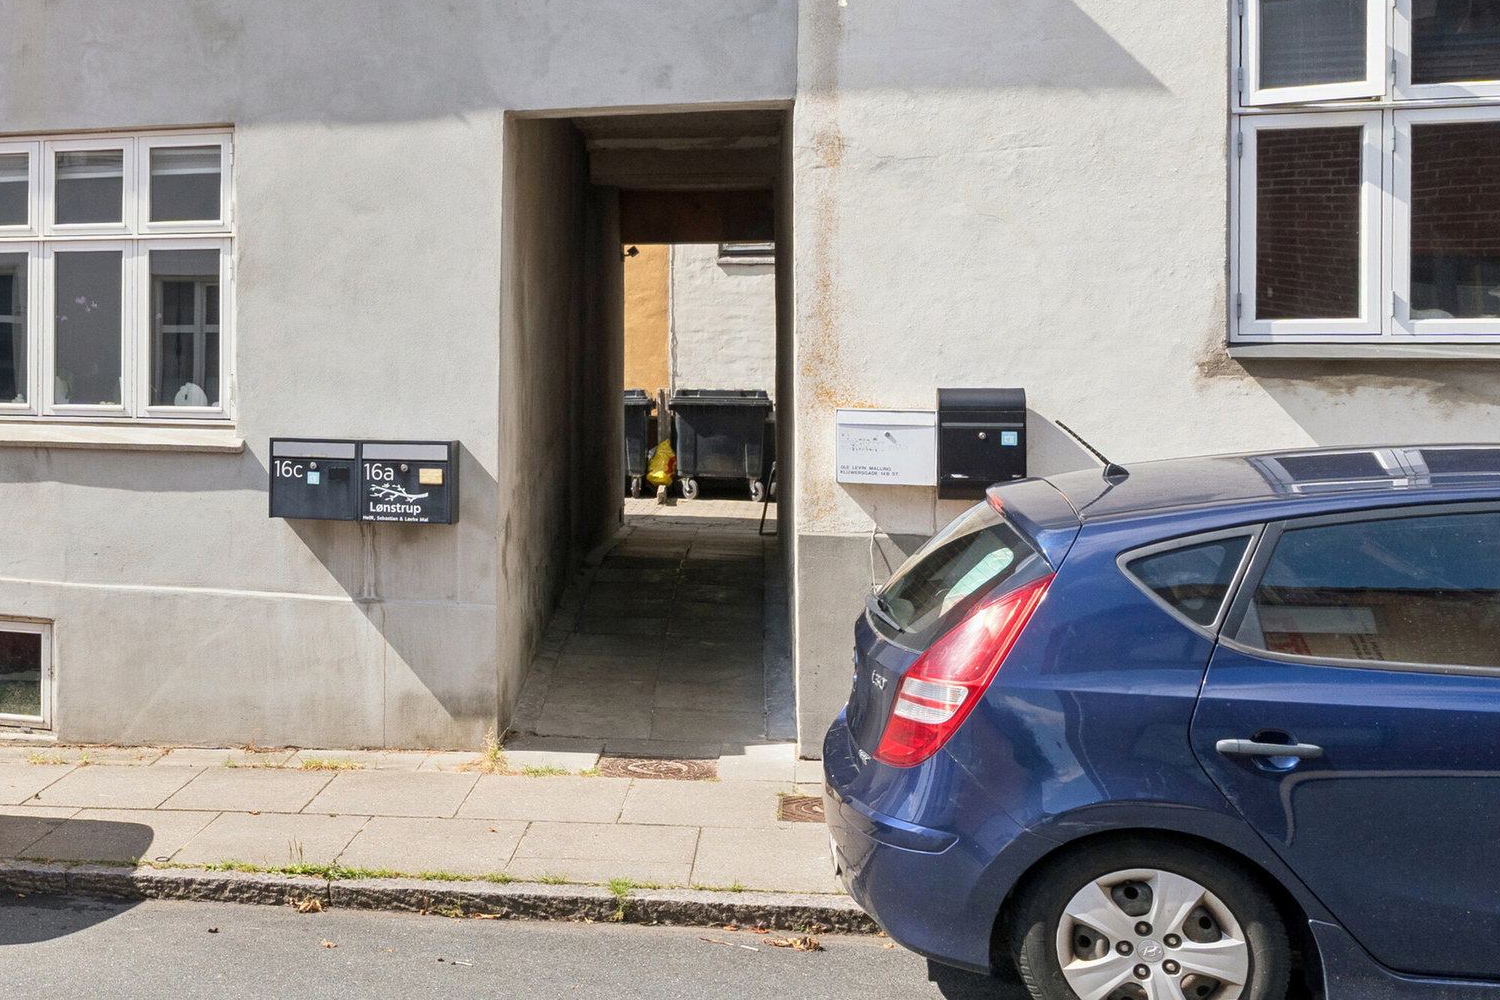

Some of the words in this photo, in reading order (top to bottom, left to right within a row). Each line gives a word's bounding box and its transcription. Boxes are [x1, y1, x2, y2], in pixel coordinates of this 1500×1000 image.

[274, 460, 303, 478] 16c
[363, 463, 394, 481] 16a
[370, 501, 422, 516] Lønstrup
